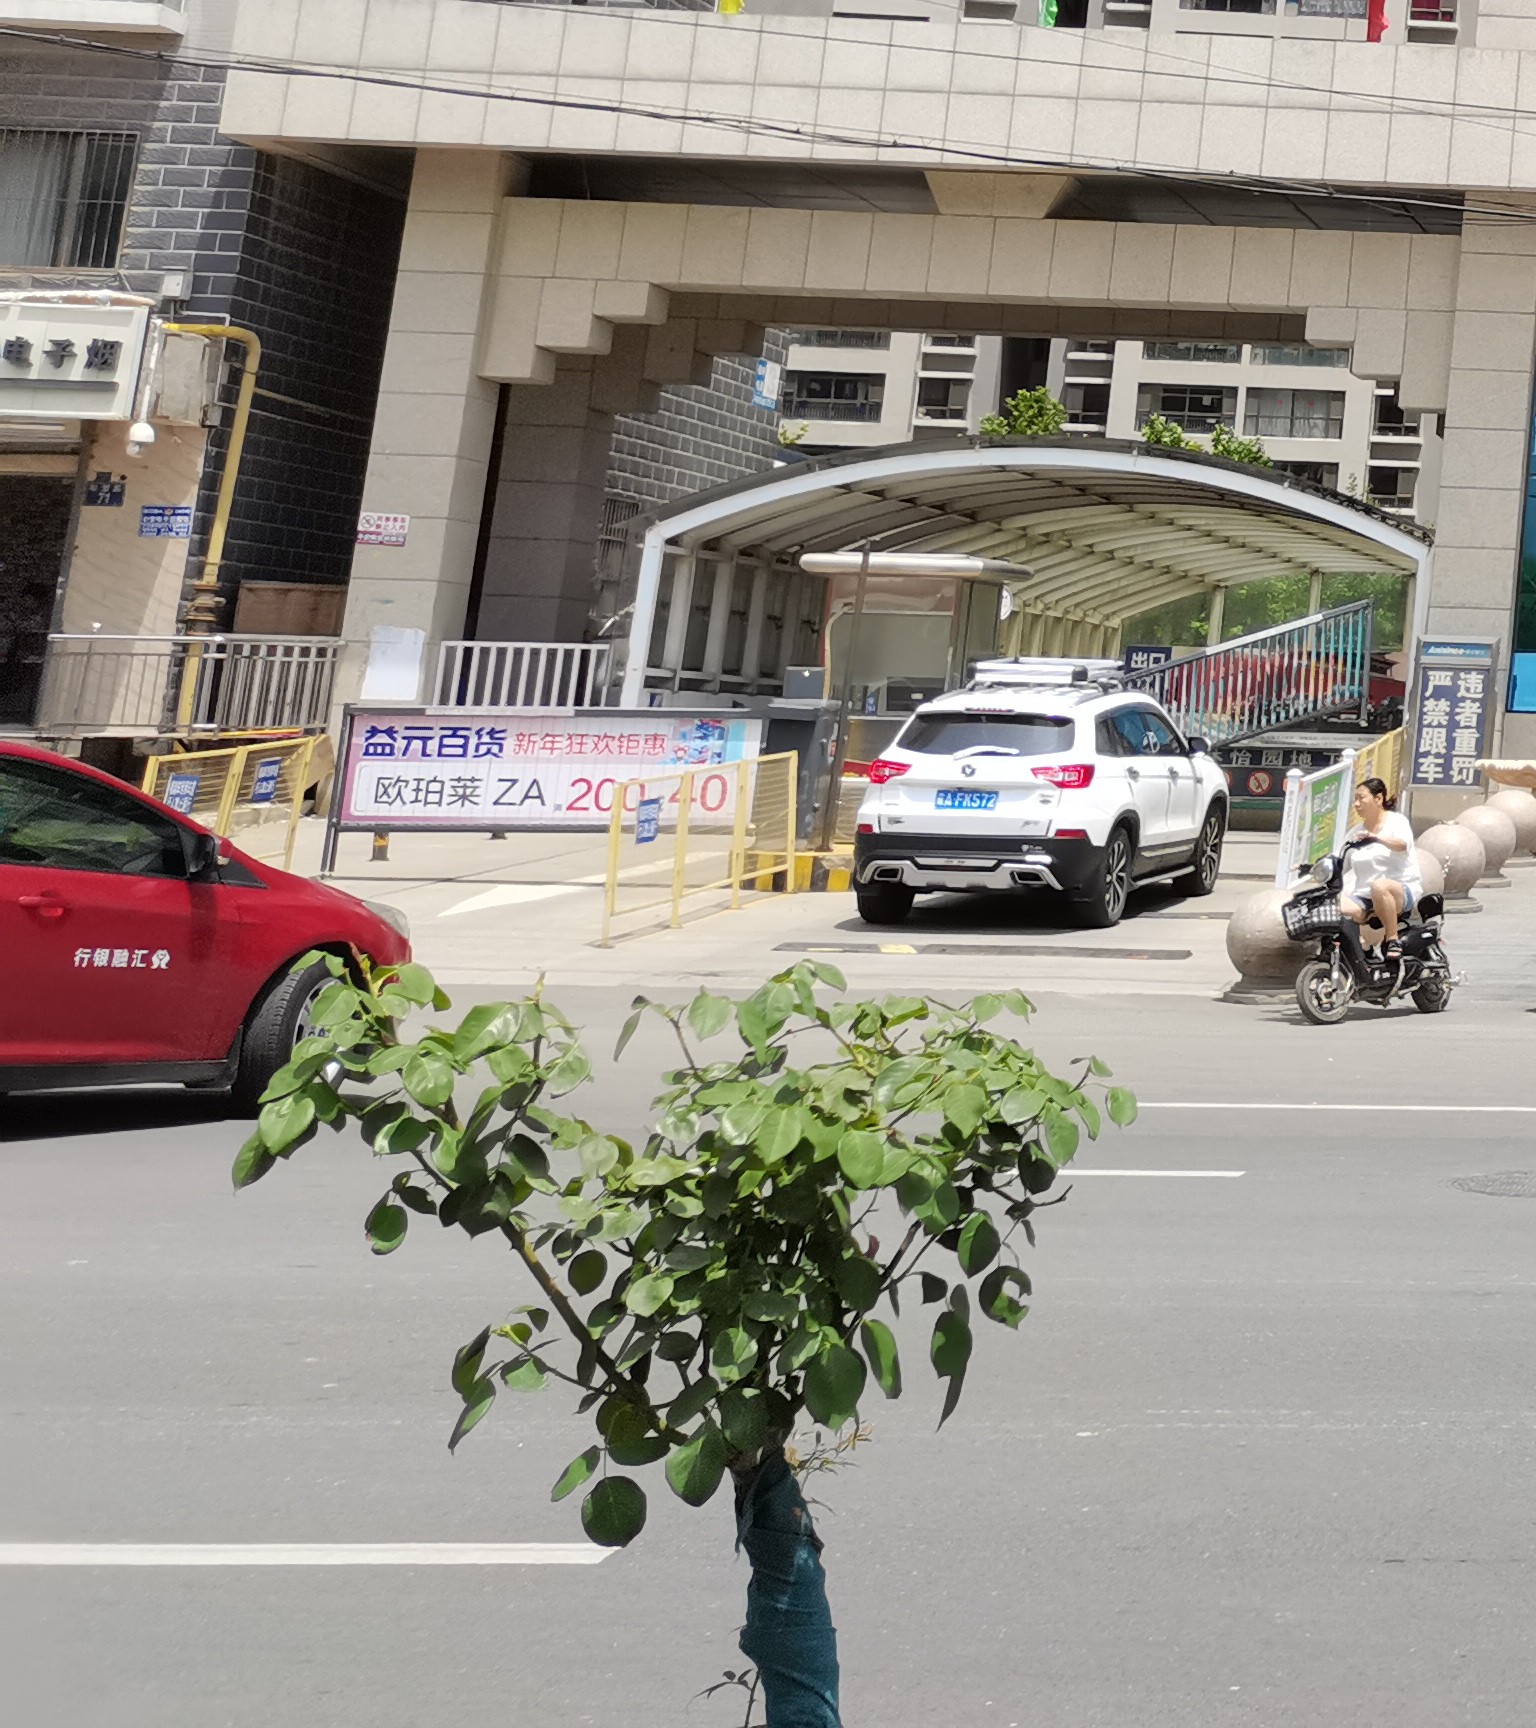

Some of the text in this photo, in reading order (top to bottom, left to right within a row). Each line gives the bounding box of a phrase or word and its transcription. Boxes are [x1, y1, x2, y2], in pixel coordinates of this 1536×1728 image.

[2, 336, 123, 370] 电子烟
[1130, 651, 1166, 670] 出口
[361, 725, 667, 760] 益元百货 新年狂欢钜惠
[1416, 670, 1454, 784] 严禁跟车
[1449, 671, 1485, 785] 违者重罚
[374, 774, 482, 808] 欧珀莱
[492, 777, 547, 807] ZA
